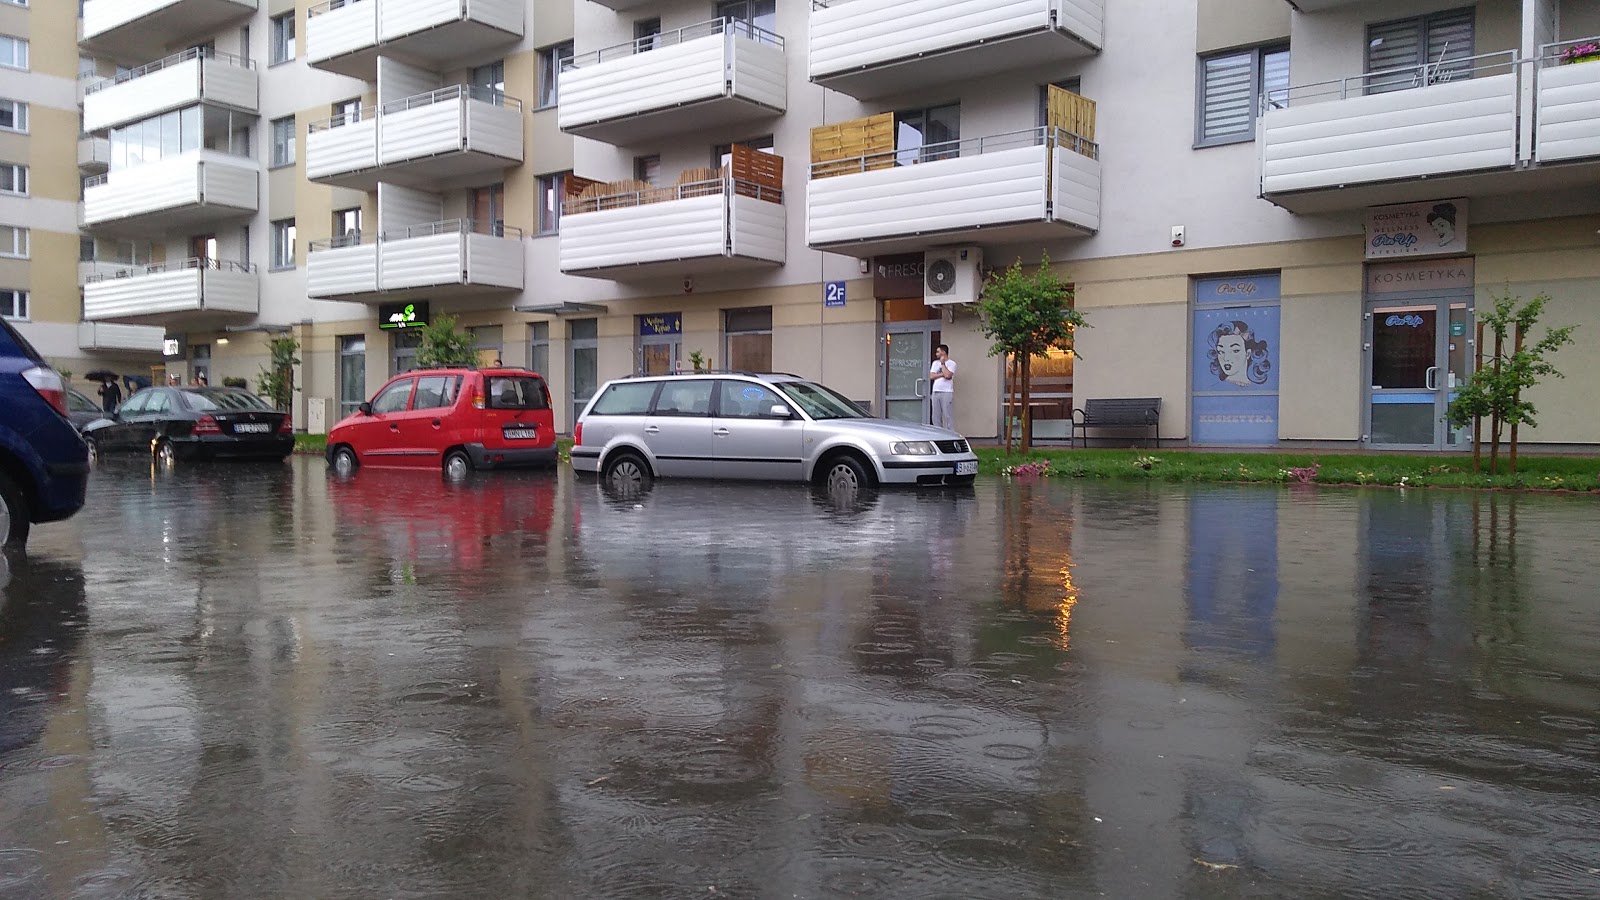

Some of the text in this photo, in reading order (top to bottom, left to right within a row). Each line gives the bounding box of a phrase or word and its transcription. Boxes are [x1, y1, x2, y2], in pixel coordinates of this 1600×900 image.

[1373, 211, 1420, 220] KOSMETYKA
[1374, 225, 1420, 233] WELLNESS
[1372, 247, 1418, 255] ATELIER
[1374, 269, 1466, 283] KOSMETYKA
[828, 283, 844, 301] 2F
[1206, 310, 1268, 318] ATELIER
[1199, 414, 1274, 423] KOSMETYKA
